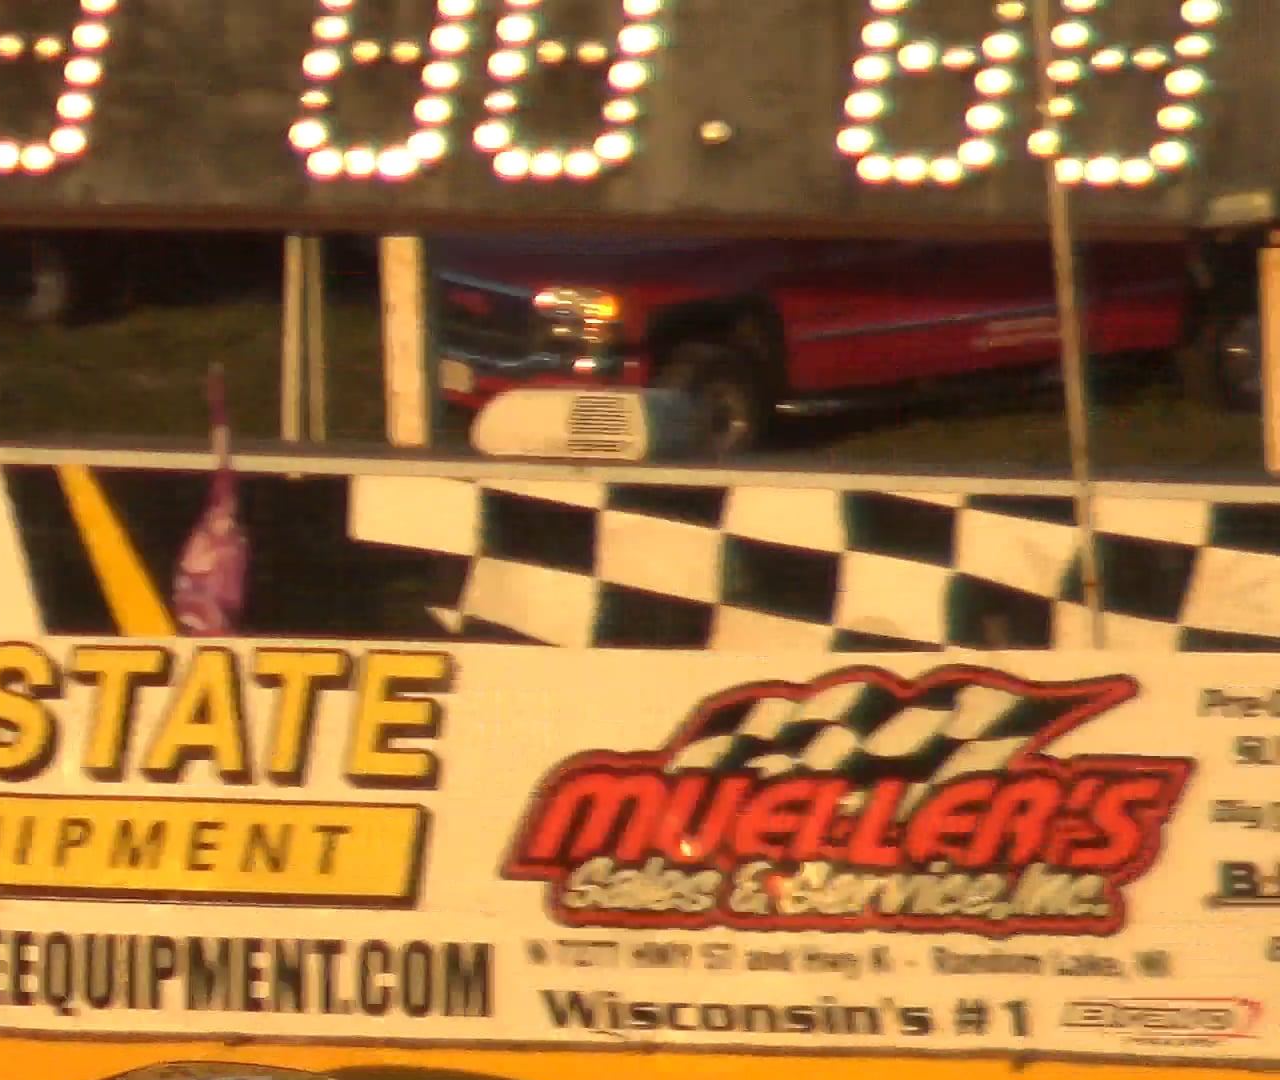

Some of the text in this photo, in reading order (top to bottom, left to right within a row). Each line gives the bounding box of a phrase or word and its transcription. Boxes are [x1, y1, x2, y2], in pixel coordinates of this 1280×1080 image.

[527, 770, 1166, 867] MUELLER'S
[564, 856, 722, 913] Sales
[729, 862, 771, 915] &
[536, 988, 937, 1038] Wisconsin's
